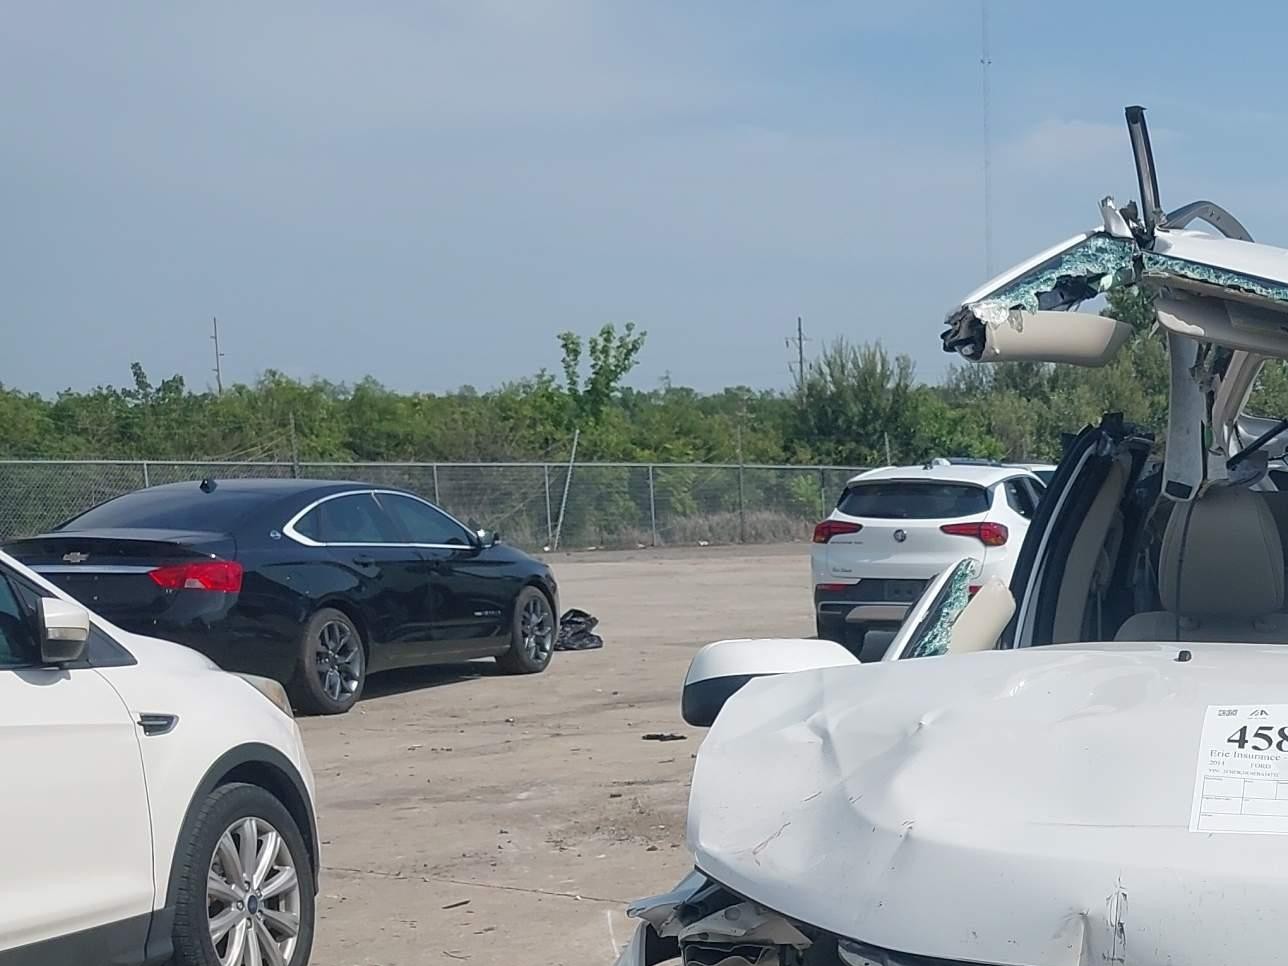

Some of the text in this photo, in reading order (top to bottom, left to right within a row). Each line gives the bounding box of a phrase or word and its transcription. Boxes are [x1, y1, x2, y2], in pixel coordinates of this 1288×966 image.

[1209, 749, 1230, 758] Erie
[1233, 750, 1281, 761] Insurance
[1250, 762, 1272, 770] FORD
